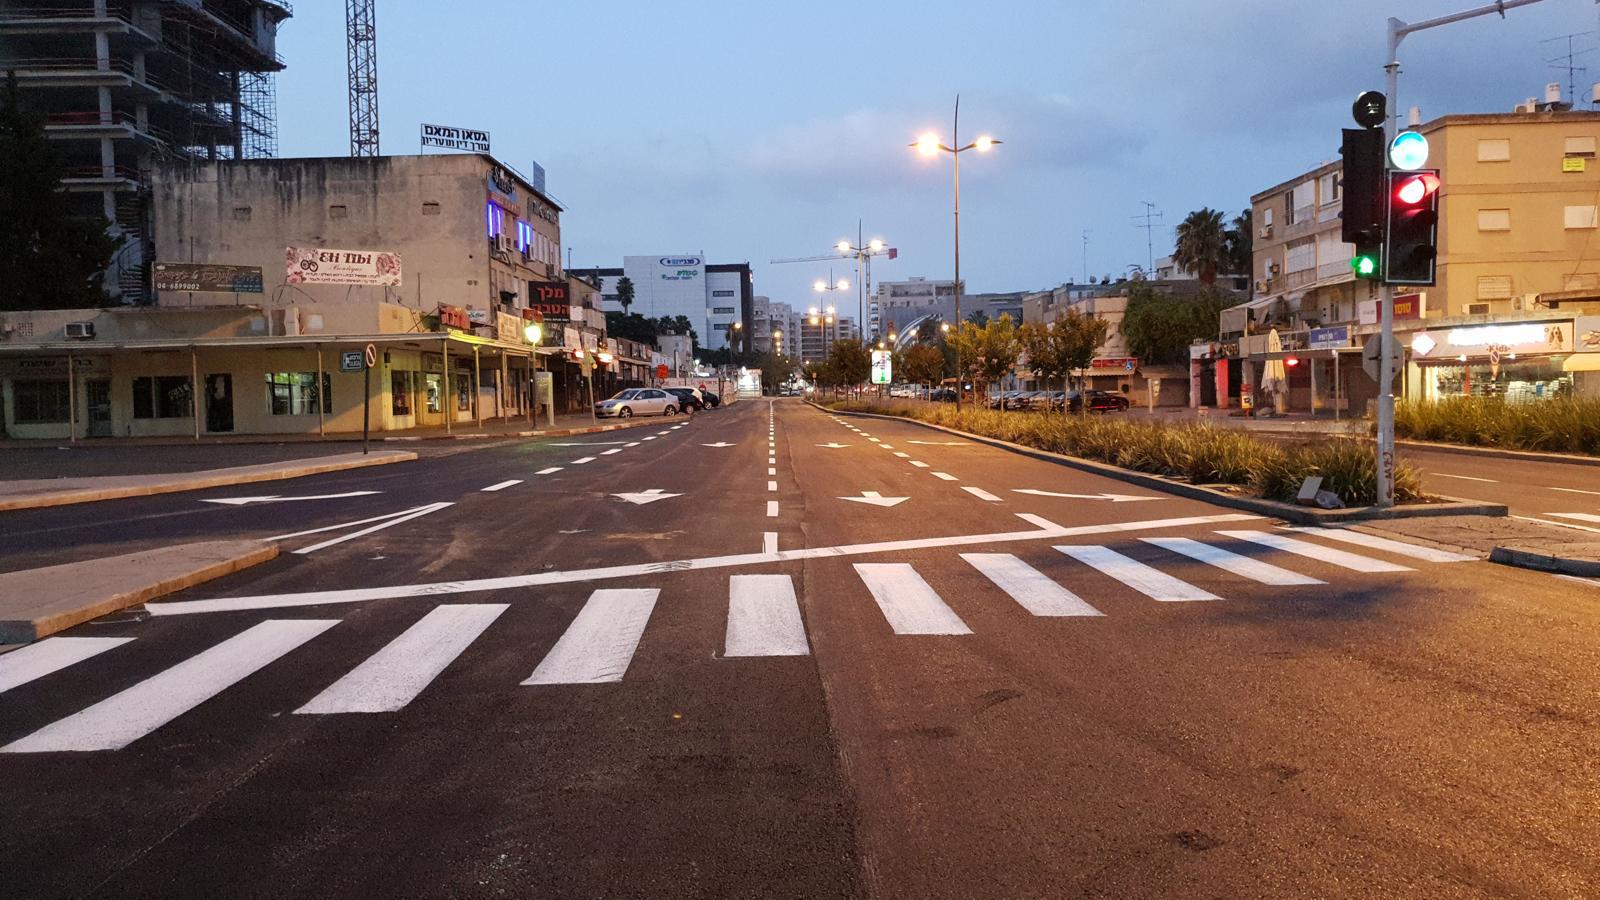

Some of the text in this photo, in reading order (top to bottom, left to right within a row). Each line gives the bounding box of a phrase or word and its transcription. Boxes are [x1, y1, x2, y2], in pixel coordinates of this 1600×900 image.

[456, 140, 469, 149] דין
[470, 141, 490, 151] עורך
[343, 252, 372, 265] Tibi
[537, 286, 565, 301] מלך
